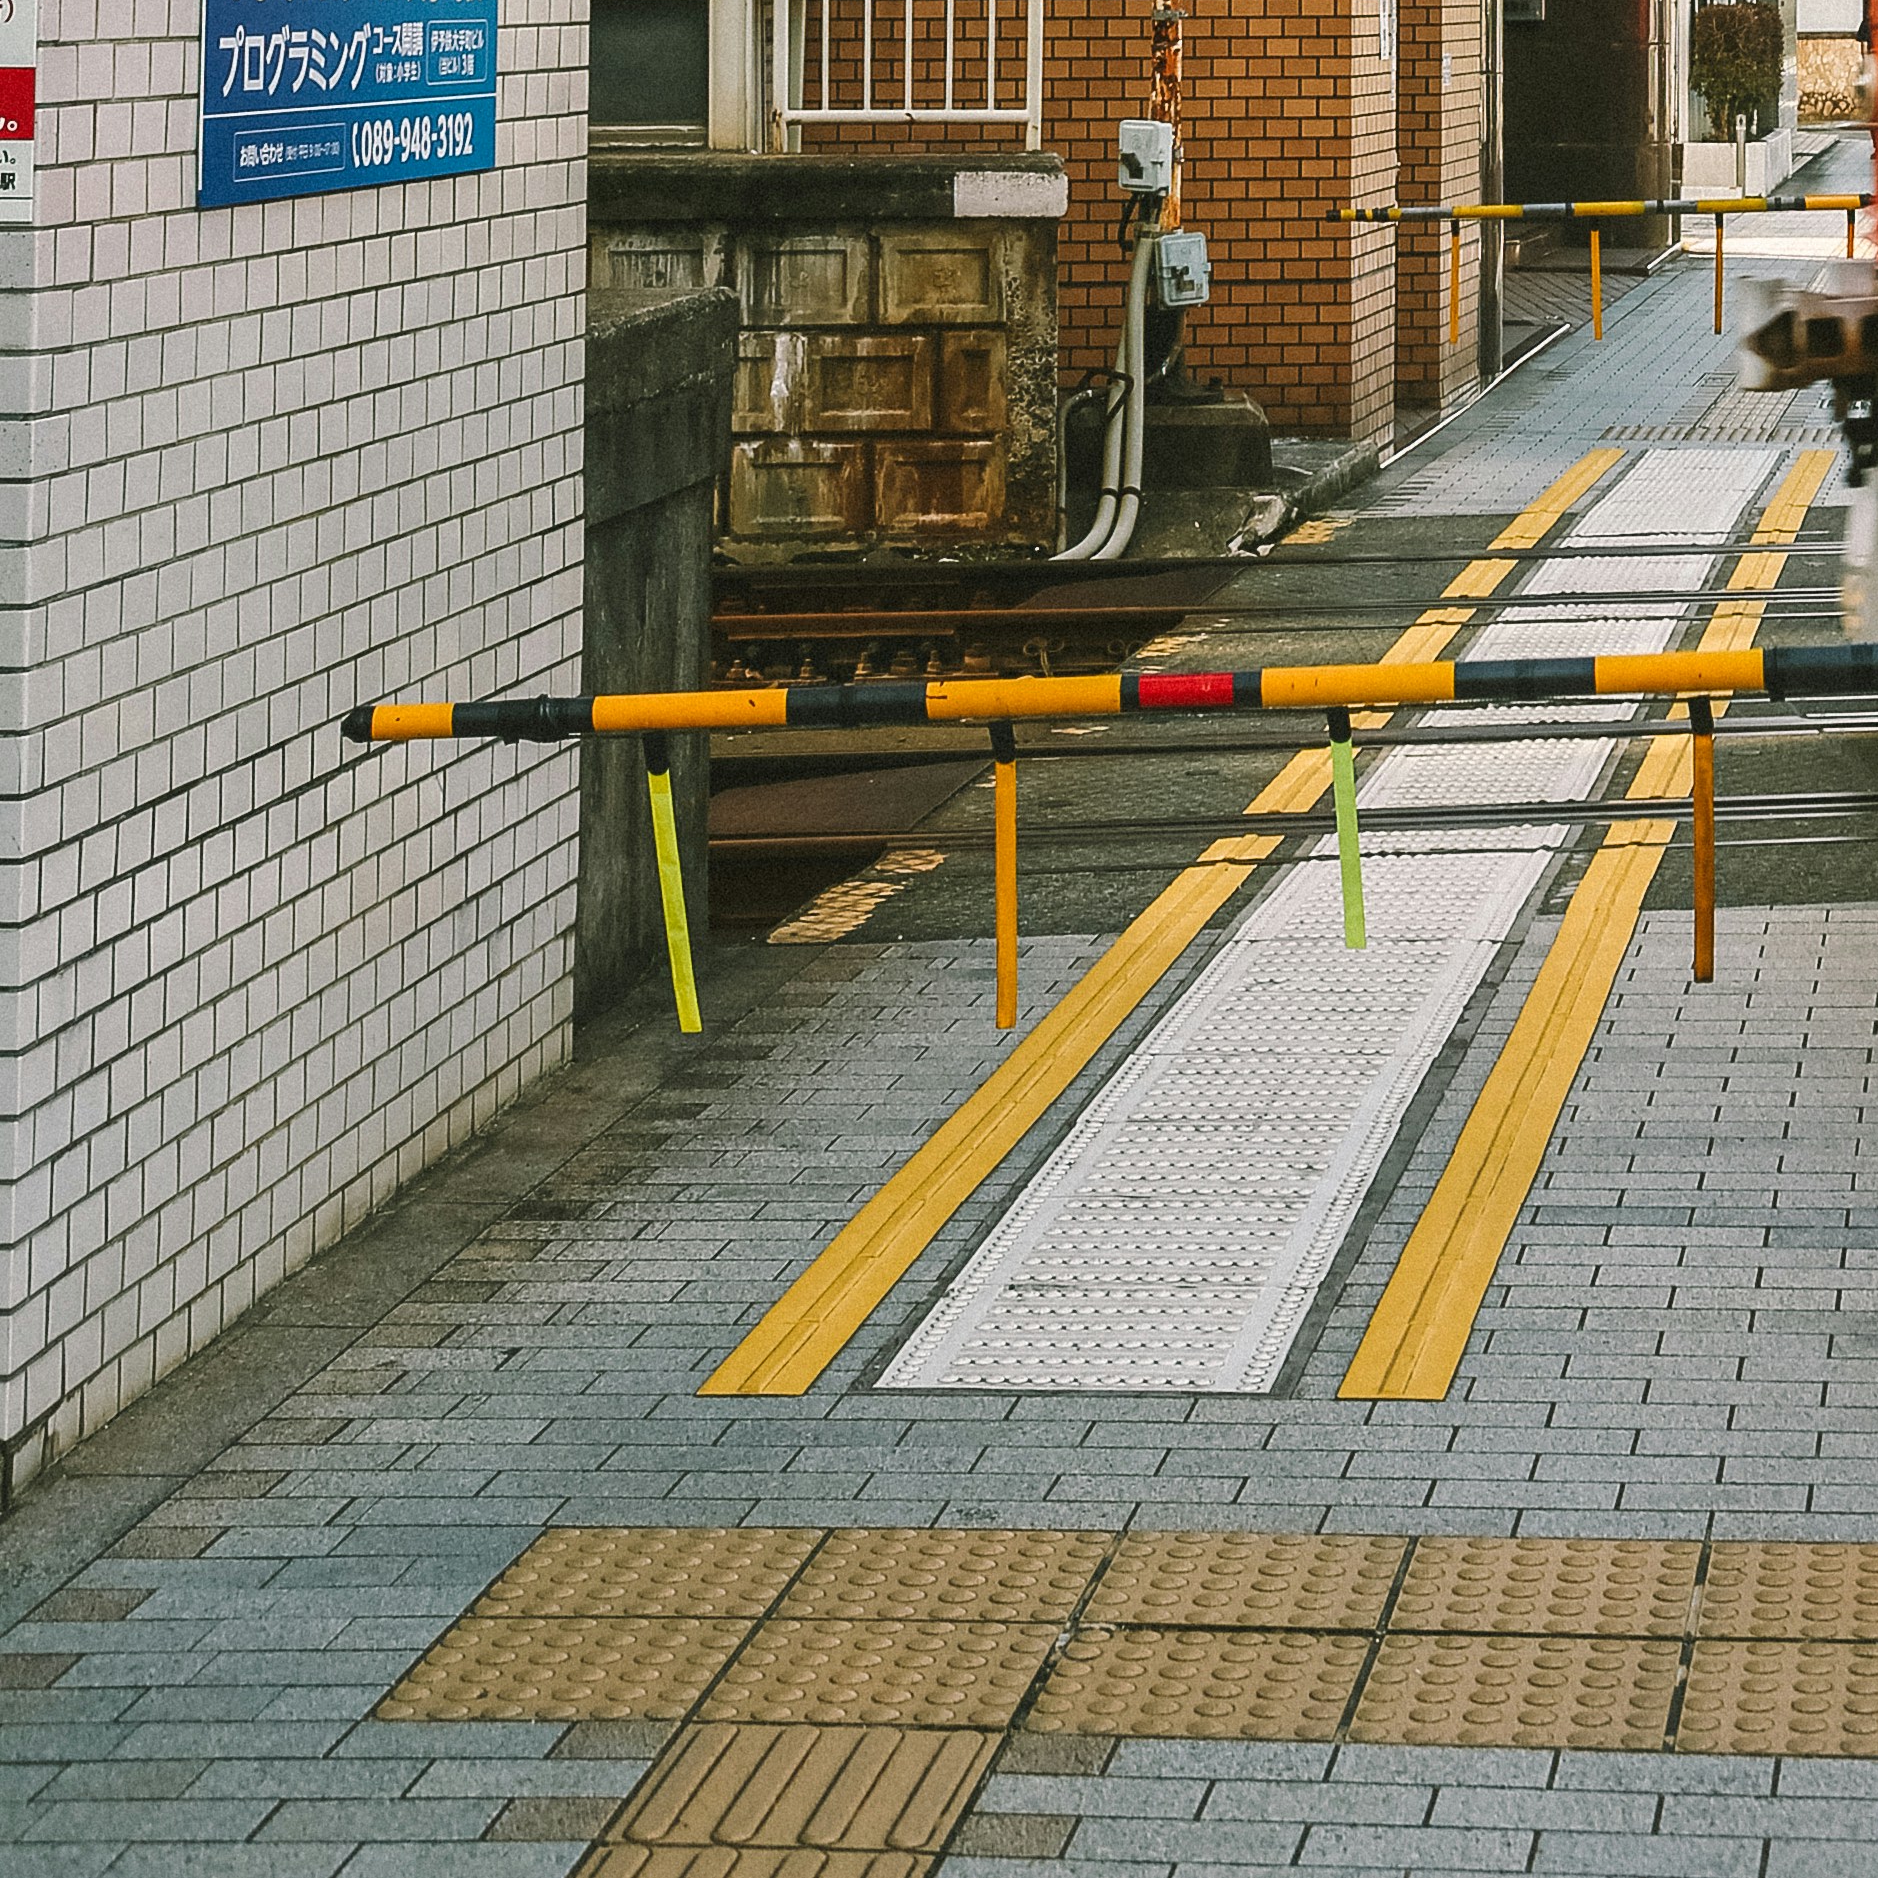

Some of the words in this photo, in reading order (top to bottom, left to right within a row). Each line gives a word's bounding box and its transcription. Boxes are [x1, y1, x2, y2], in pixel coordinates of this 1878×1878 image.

[218, 21, 372, 98] プログラミング
[361, 111, 474, 168] 089-948-3192
